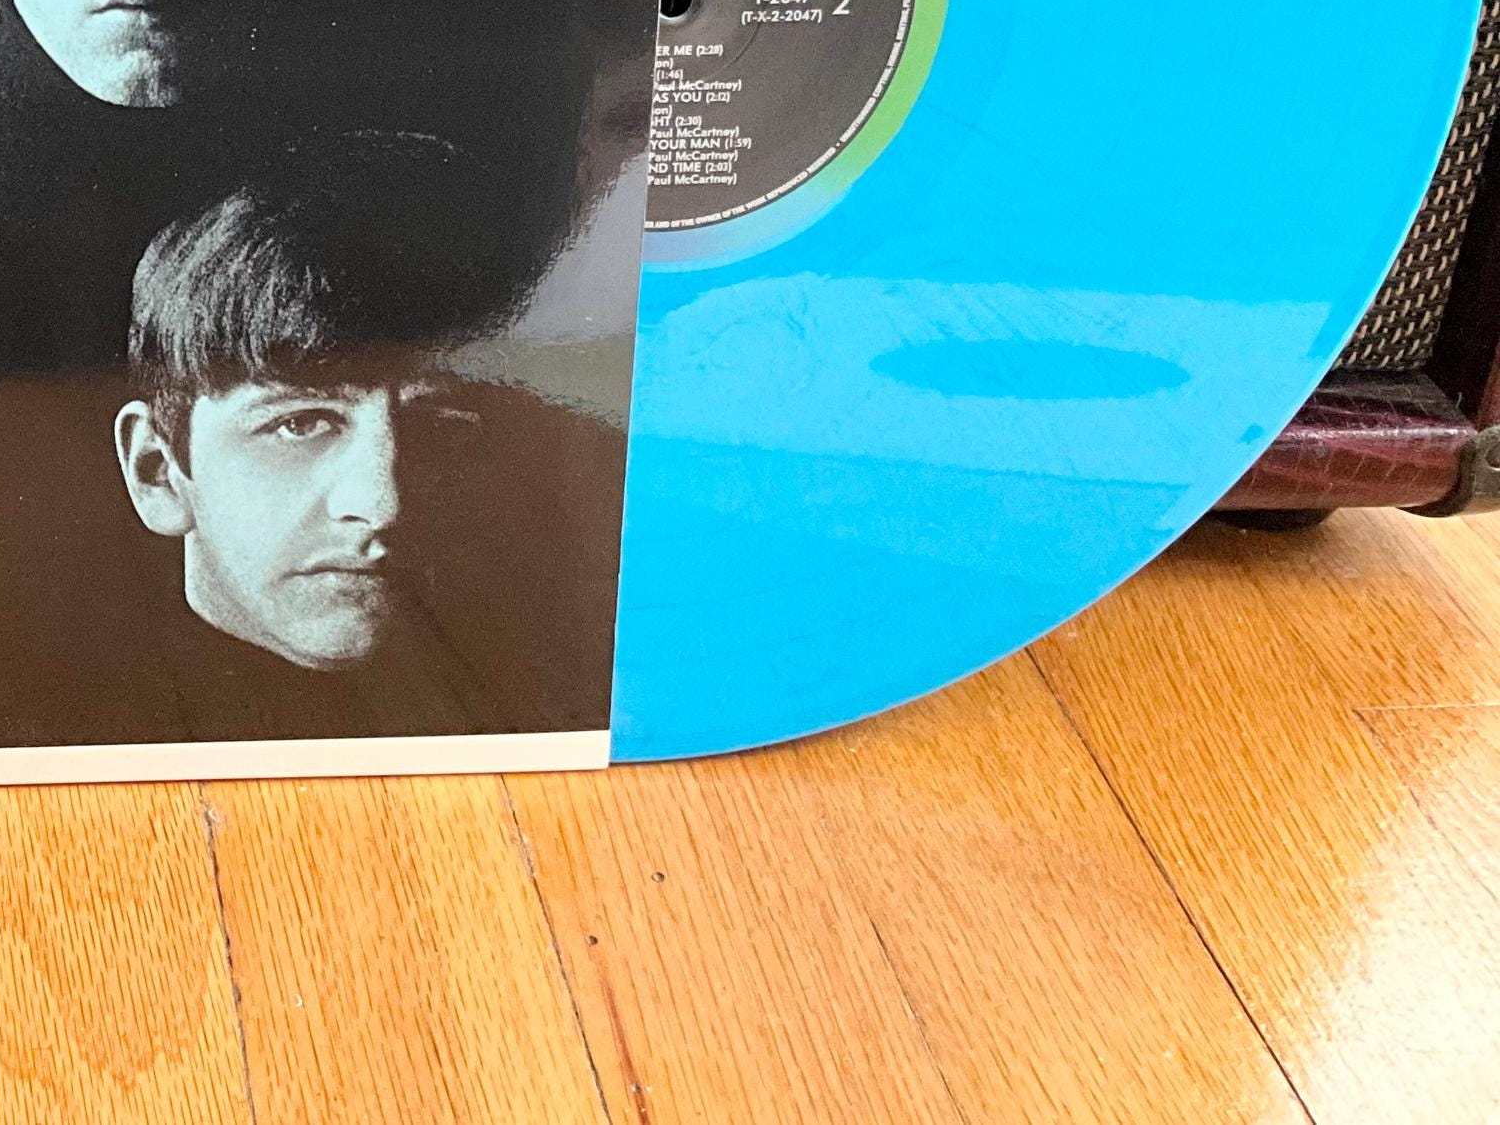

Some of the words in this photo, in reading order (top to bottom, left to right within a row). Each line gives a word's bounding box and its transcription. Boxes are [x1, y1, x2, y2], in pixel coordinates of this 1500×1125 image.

[741, 9, 822, 26] (T-X-2-2047)
[674, 45, 693, 55] ME
[679, 79, 742, 92] McCartney)
[653, 93, 669, 103] AS
[673, 92, 702, 103] YOU
[677, 126, 740, 139] McCartney)
[650, 139, 686, 150] YOUR
[690, 138, 720, 149] MAN
[676, 150, 738, 162] McCartney)
[649, 163, 668, 173] ND
[672, 162, 701, 173] TIME
[674, 173, 738, 185] McCartney)
